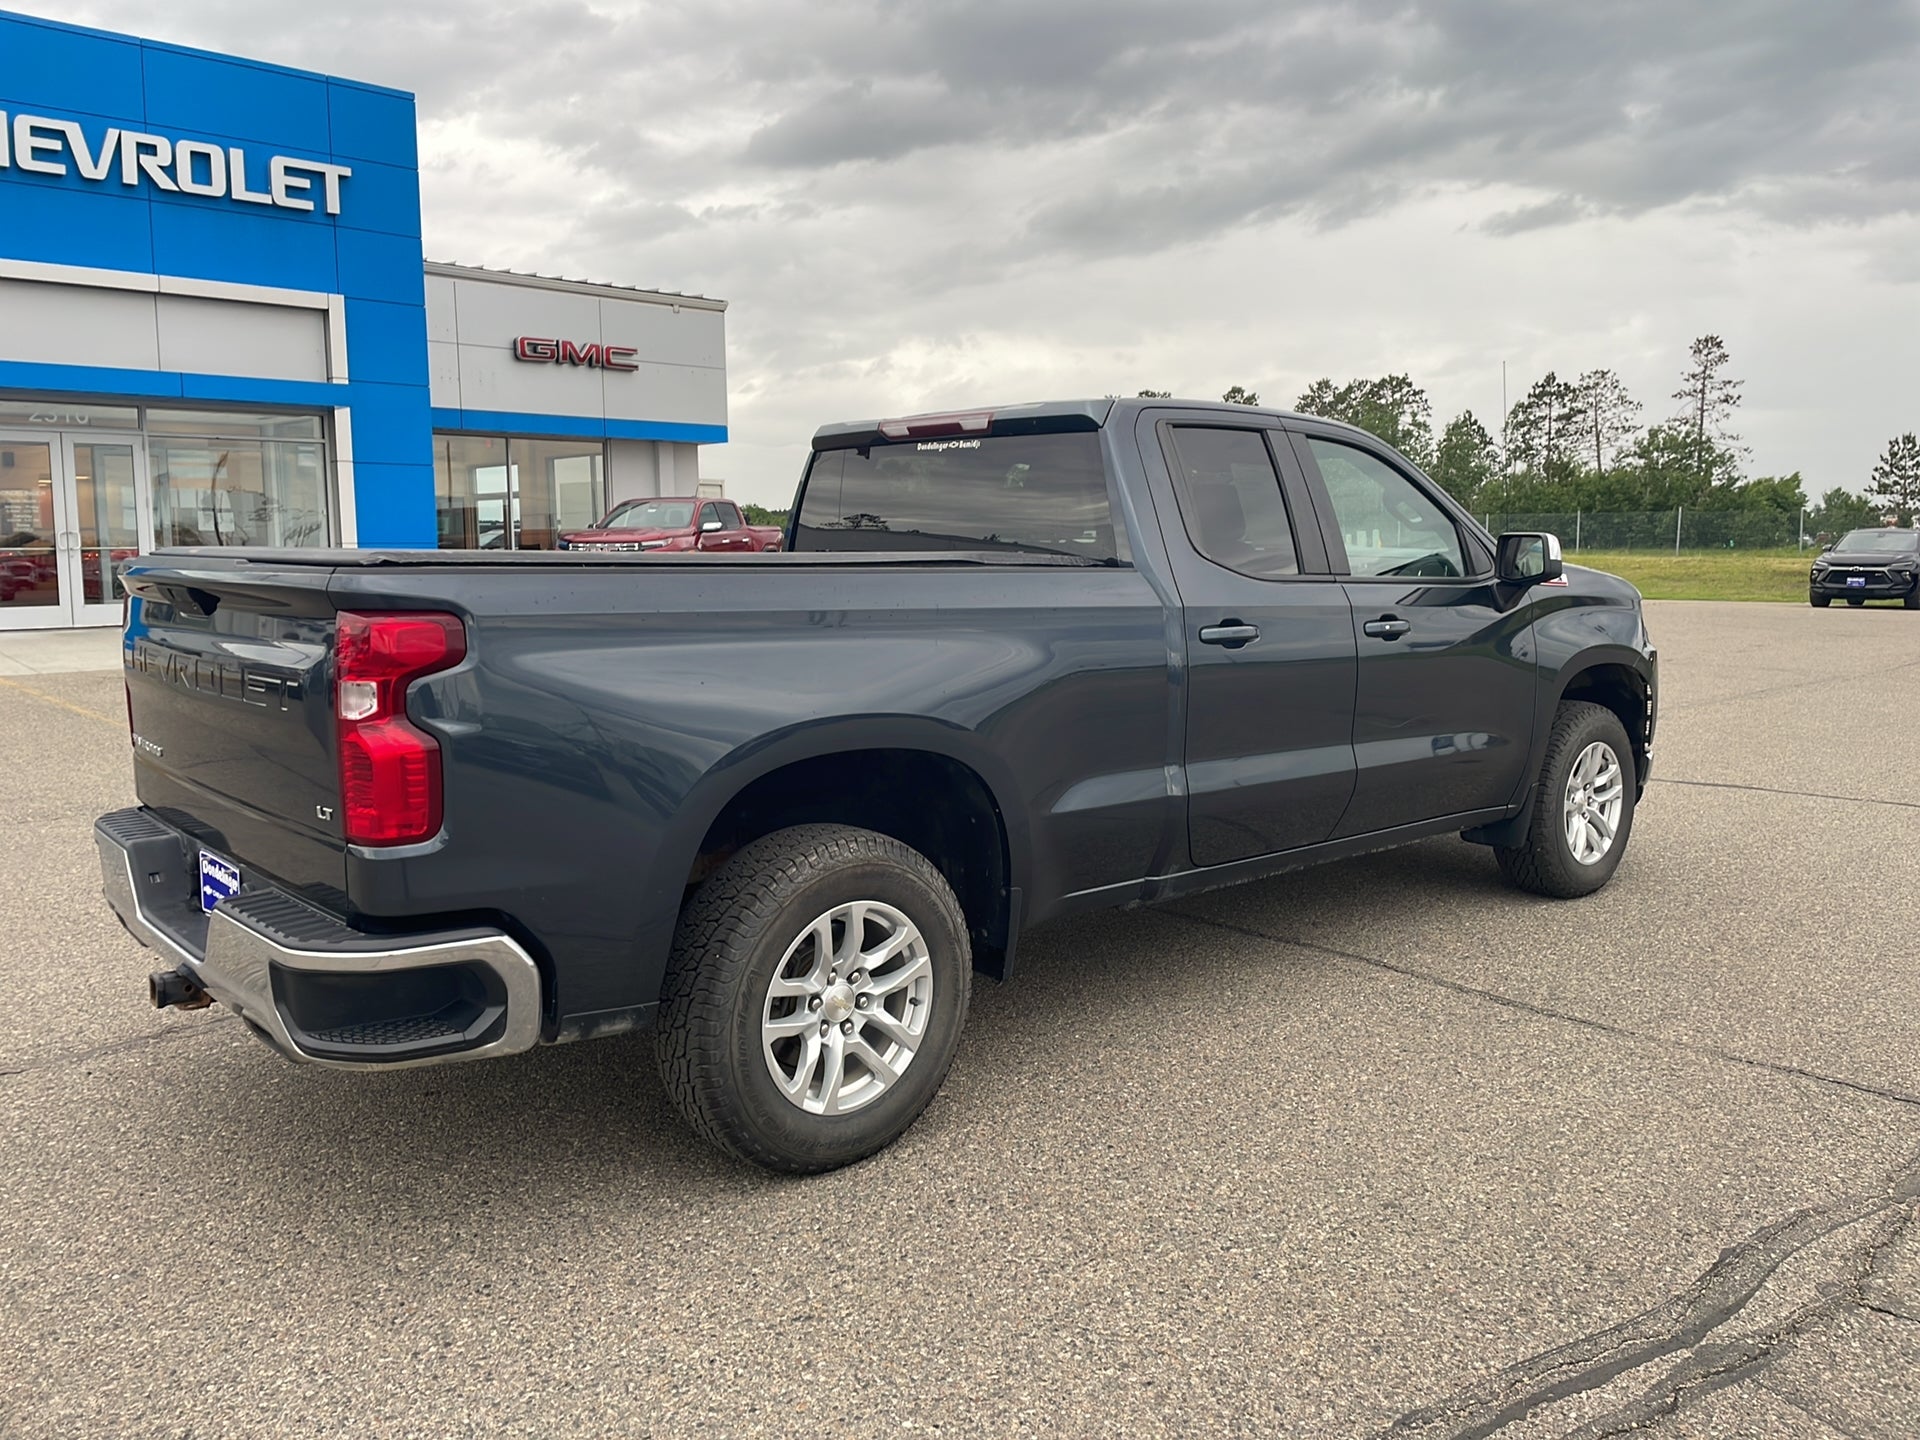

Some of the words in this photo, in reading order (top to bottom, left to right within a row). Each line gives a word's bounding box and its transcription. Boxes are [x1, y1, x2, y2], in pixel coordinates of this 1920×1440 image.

[0, 110, 352, 215] EVROLET
[514, 336, 639, 373] GMC
[316, 805, 333, 821] LT
